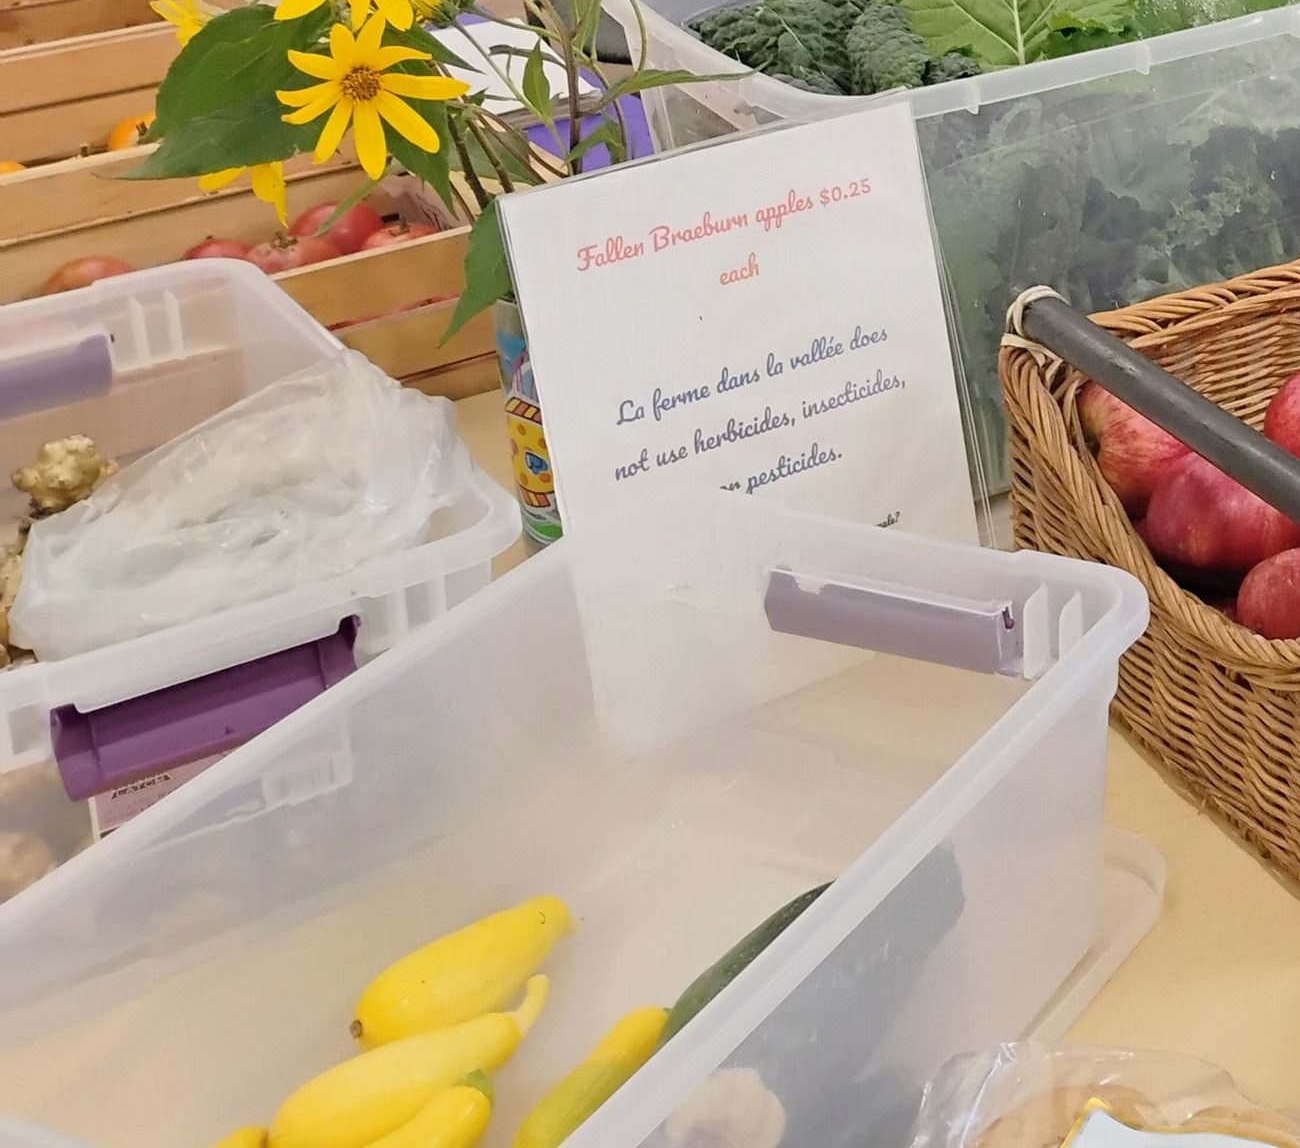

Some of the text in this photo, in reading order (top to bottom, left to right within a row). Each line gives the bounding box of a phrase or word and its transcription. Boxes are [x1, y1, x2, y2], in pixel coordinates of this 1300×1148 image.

[577, 178, 871, 271] Fallen Braeburn apples $0.25
[720, 252, 759, 285] each
[616, 326, 888, 426] La ferme dans la vallée does
[615, 369, 906, 481] not use herbicides, insecticides,
[745, 442, 843, 494] pesticides.
